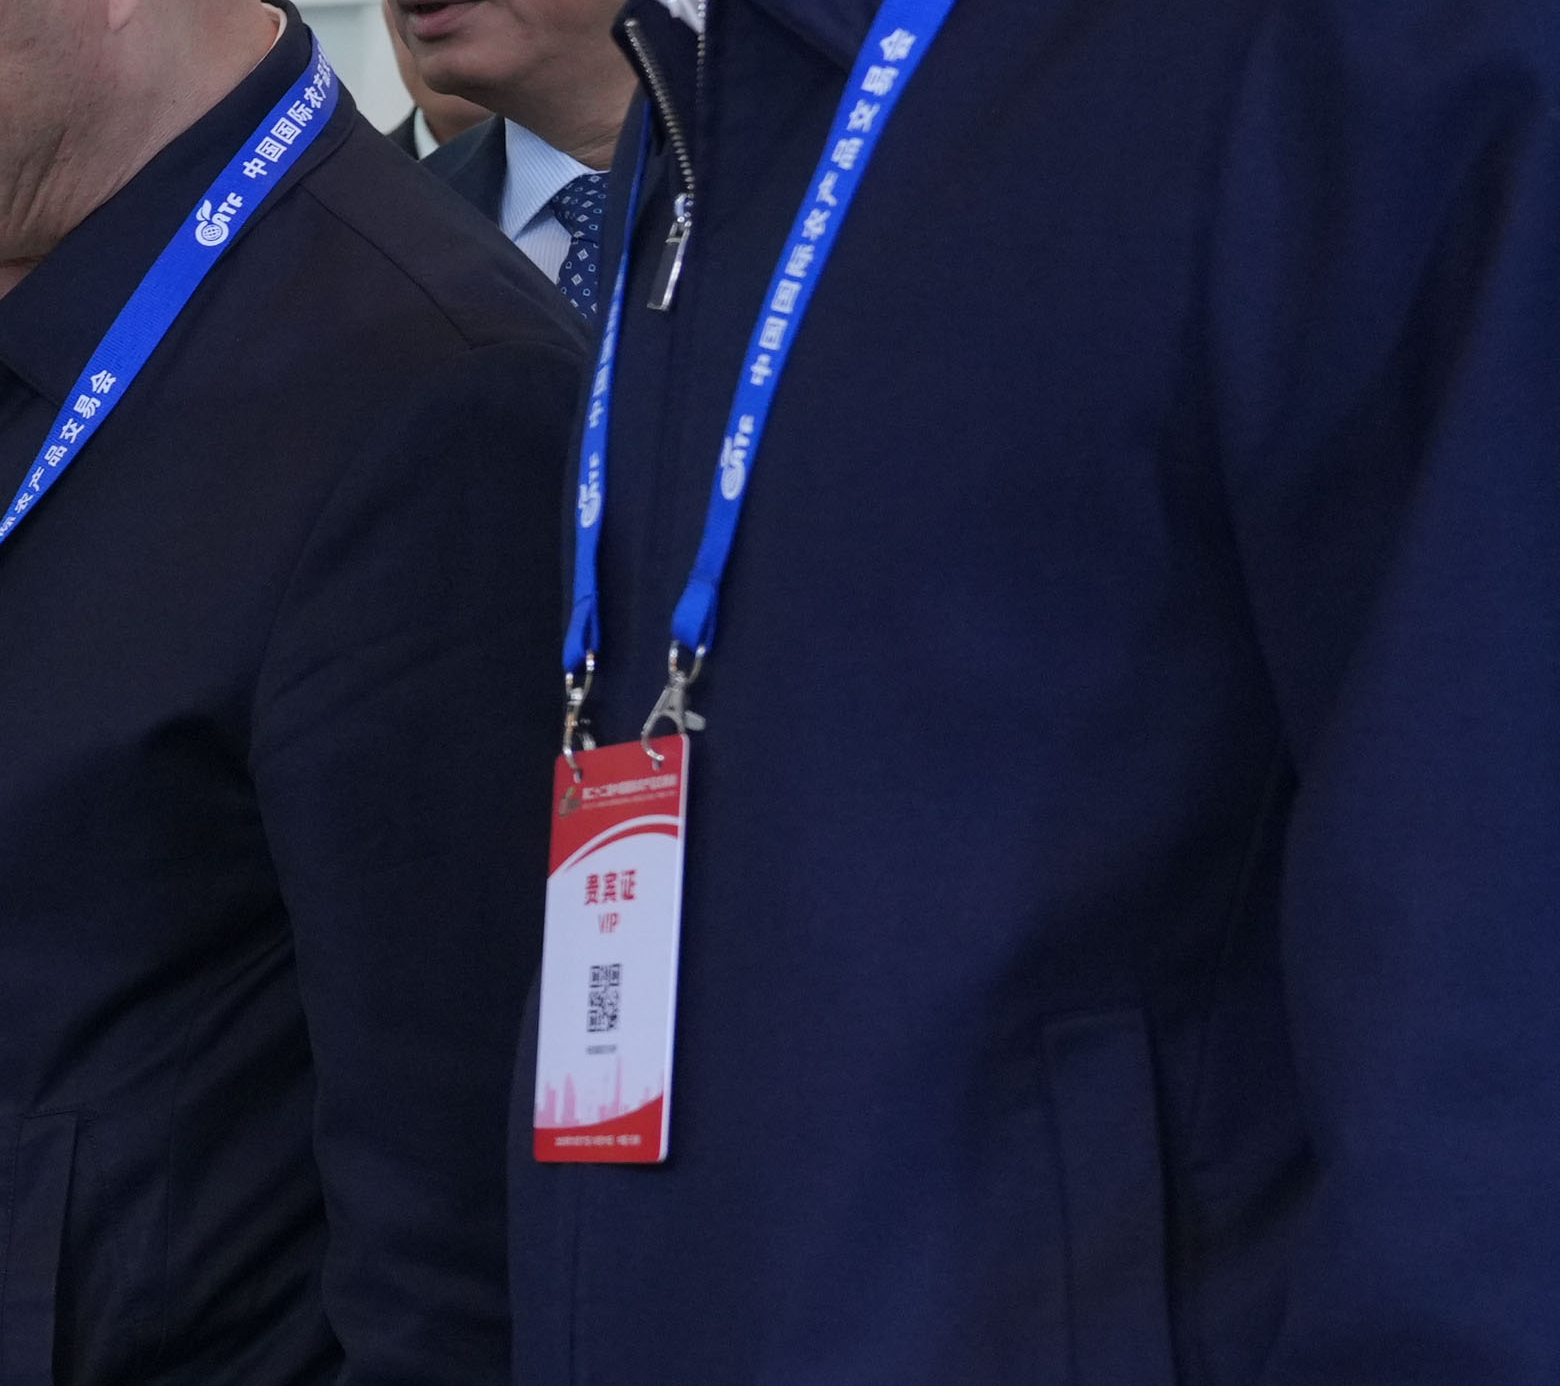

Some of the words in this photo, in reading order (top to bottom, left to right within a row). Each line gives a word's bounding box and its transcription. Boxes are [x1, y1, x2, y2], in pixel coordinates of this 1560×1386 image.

[750, 28, 917, 386] 中国国际农产品交易会
[585, 869, 638, 906] 贵宾证
[598, 913, 618, 934] VIP
